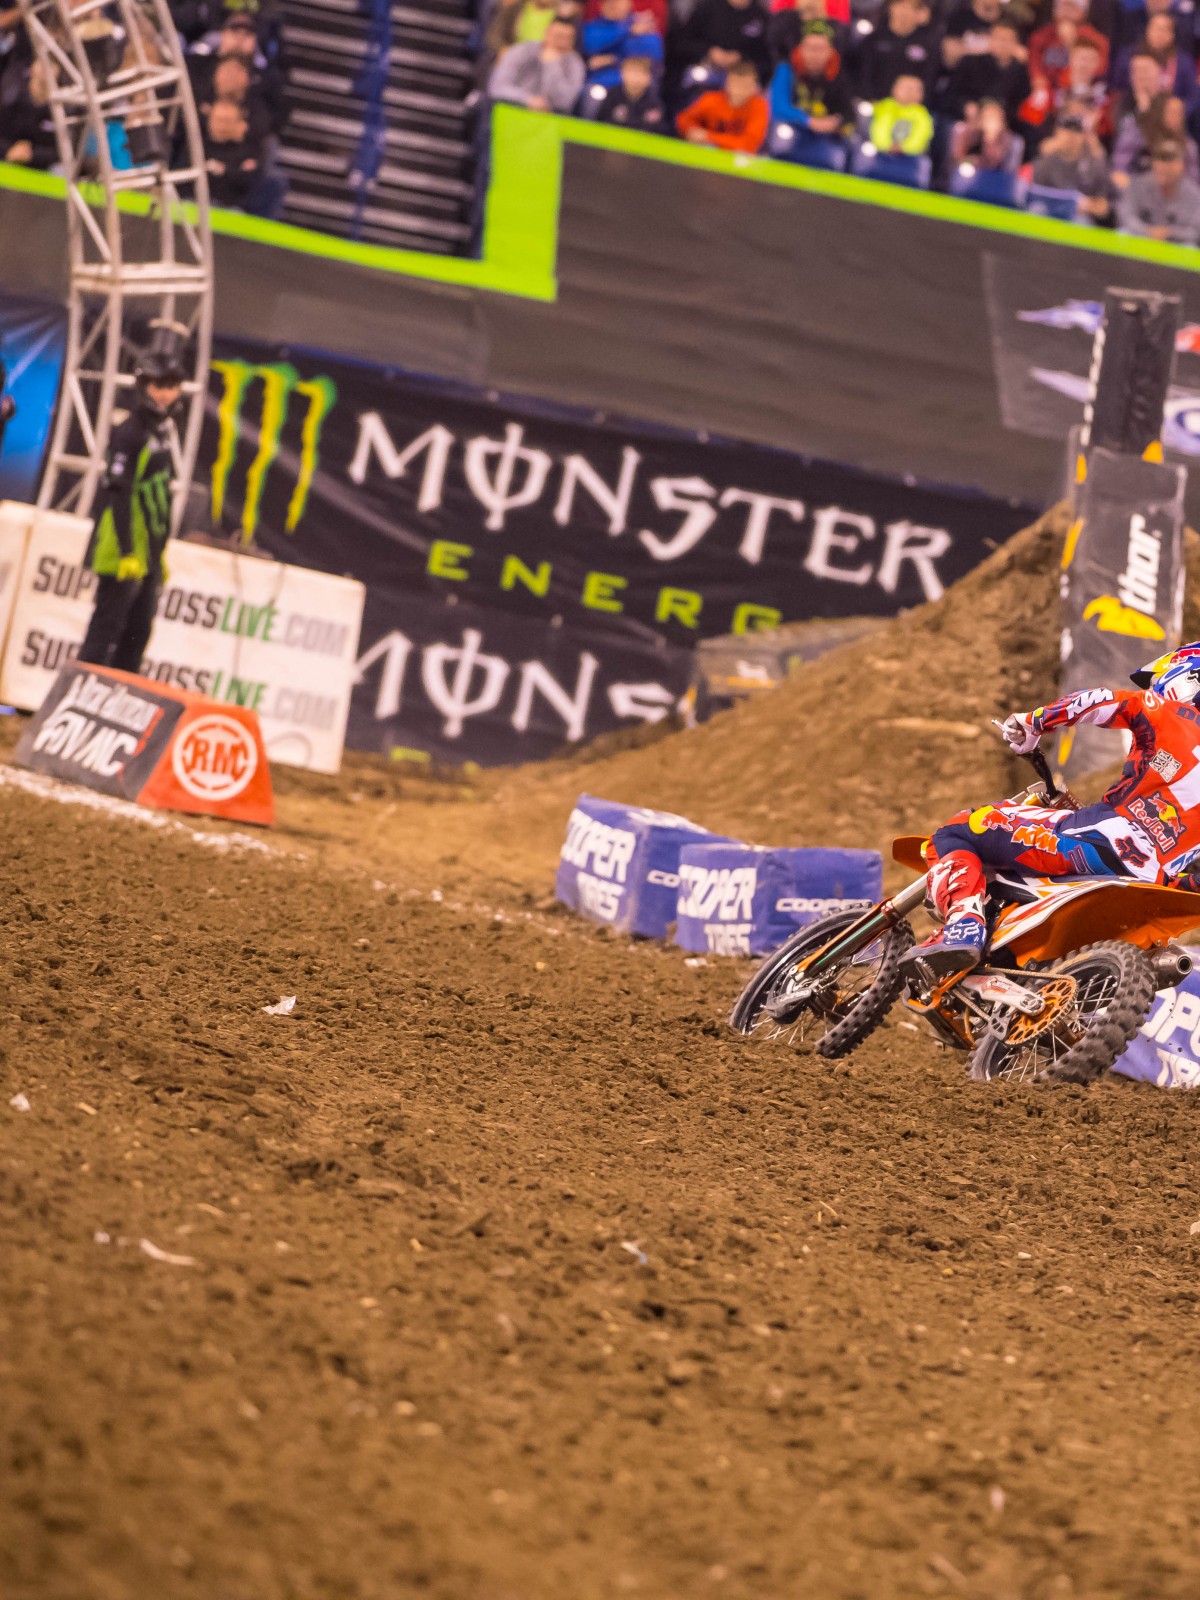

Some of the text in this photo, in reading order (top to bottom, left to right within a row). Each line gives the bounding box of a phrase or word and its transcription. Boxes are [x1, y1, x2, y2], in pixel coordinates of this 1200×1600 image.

[427, 539, 782, 636] ENERG
[1117, 513, 1161, 615] thor
[1065, 688, 1114, 720] KTM
[561, 807, 637, 884] COOPER
[1010, 824, 1060, 855] KTM
[676, 864, 757, 921] COOPER
